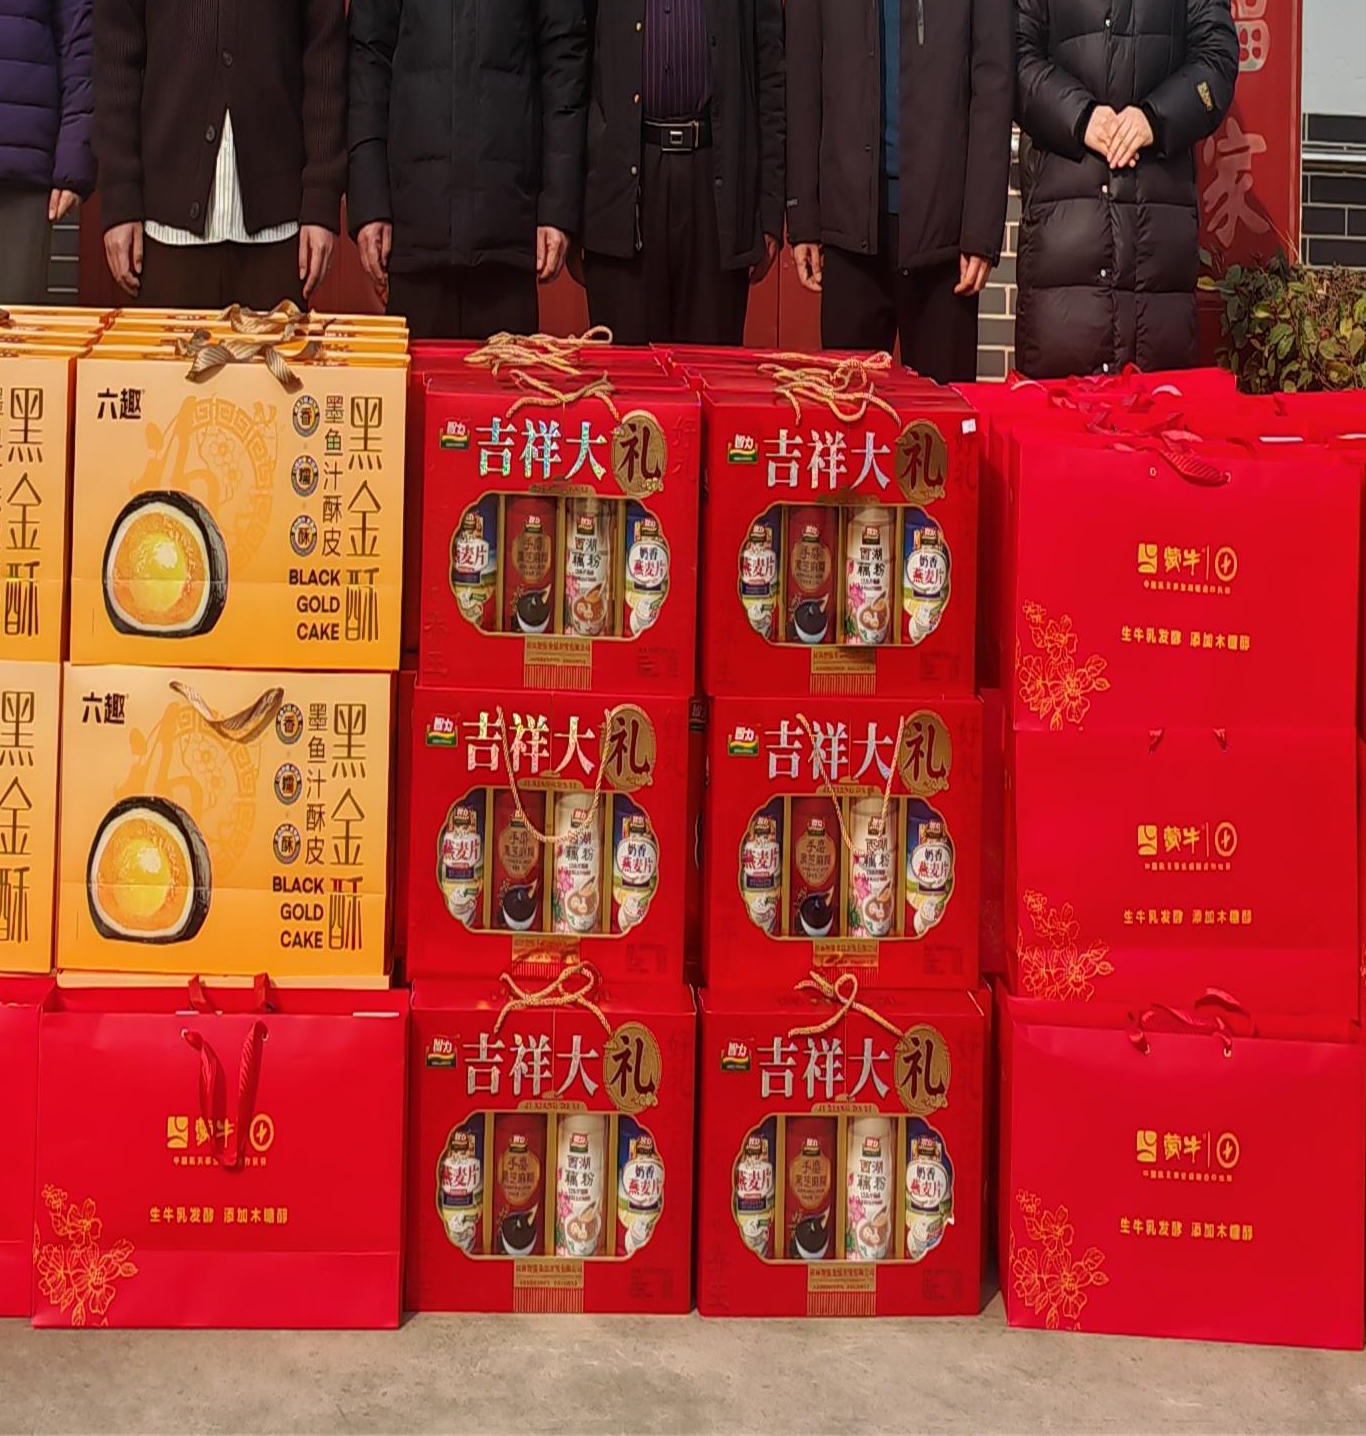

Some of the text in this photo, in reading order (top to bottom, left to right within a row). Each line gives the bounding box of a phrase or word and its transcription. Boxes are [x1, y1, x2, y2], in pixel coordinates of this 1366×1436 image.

[98, 388, 141, 419] 六趣
[475, 417, 664, 481] 吉祥大礼
[764, 429, 944, 489] 吉祥大礼
[322, 395, 344, 557] 墨鱼汁酥皮
[5, 388, 43, 636] 黑金酥
[345, 397, 382, 641] 黑金酥
[1164, 546, 1201, 576] 蒙牛
[289, 569, 340, 586] BLACK
[297, 596, 340, 613] GOLD
[297, 623, 339, 640] CAKE
[1121, 626, 1181, 645] 生牛乳发酵
[82, 692, 125, 724] 六趣
[463, 711, 649, 774] 吉祥大礼
[765, 720, 946, 780] 吉祥大礼
[305, 703, 328, 865] 墨鱼汁酥皮
[329, 703, 367, 950] 黑金酥
[1164, 826, 1200, 854] 蒙牛
[273, 876, 324, 894] BLACK
[281, 903, 324, 921] GOLD
[1124, 910, 1183, 924] 生牛乳发酵
[281, 931, 324, 948] CAKE
[463, 1033, 655, 1096] 吉祥大礼
[756, 1037, 945, 1099] 吉祥大礼
[1164, 1132, 1201, 1163] 蒙牛
[150, 1206, 214, 1223] 生牛乳发酵
[1120, 1217, 1182, 1236] 生牛乳发酵
